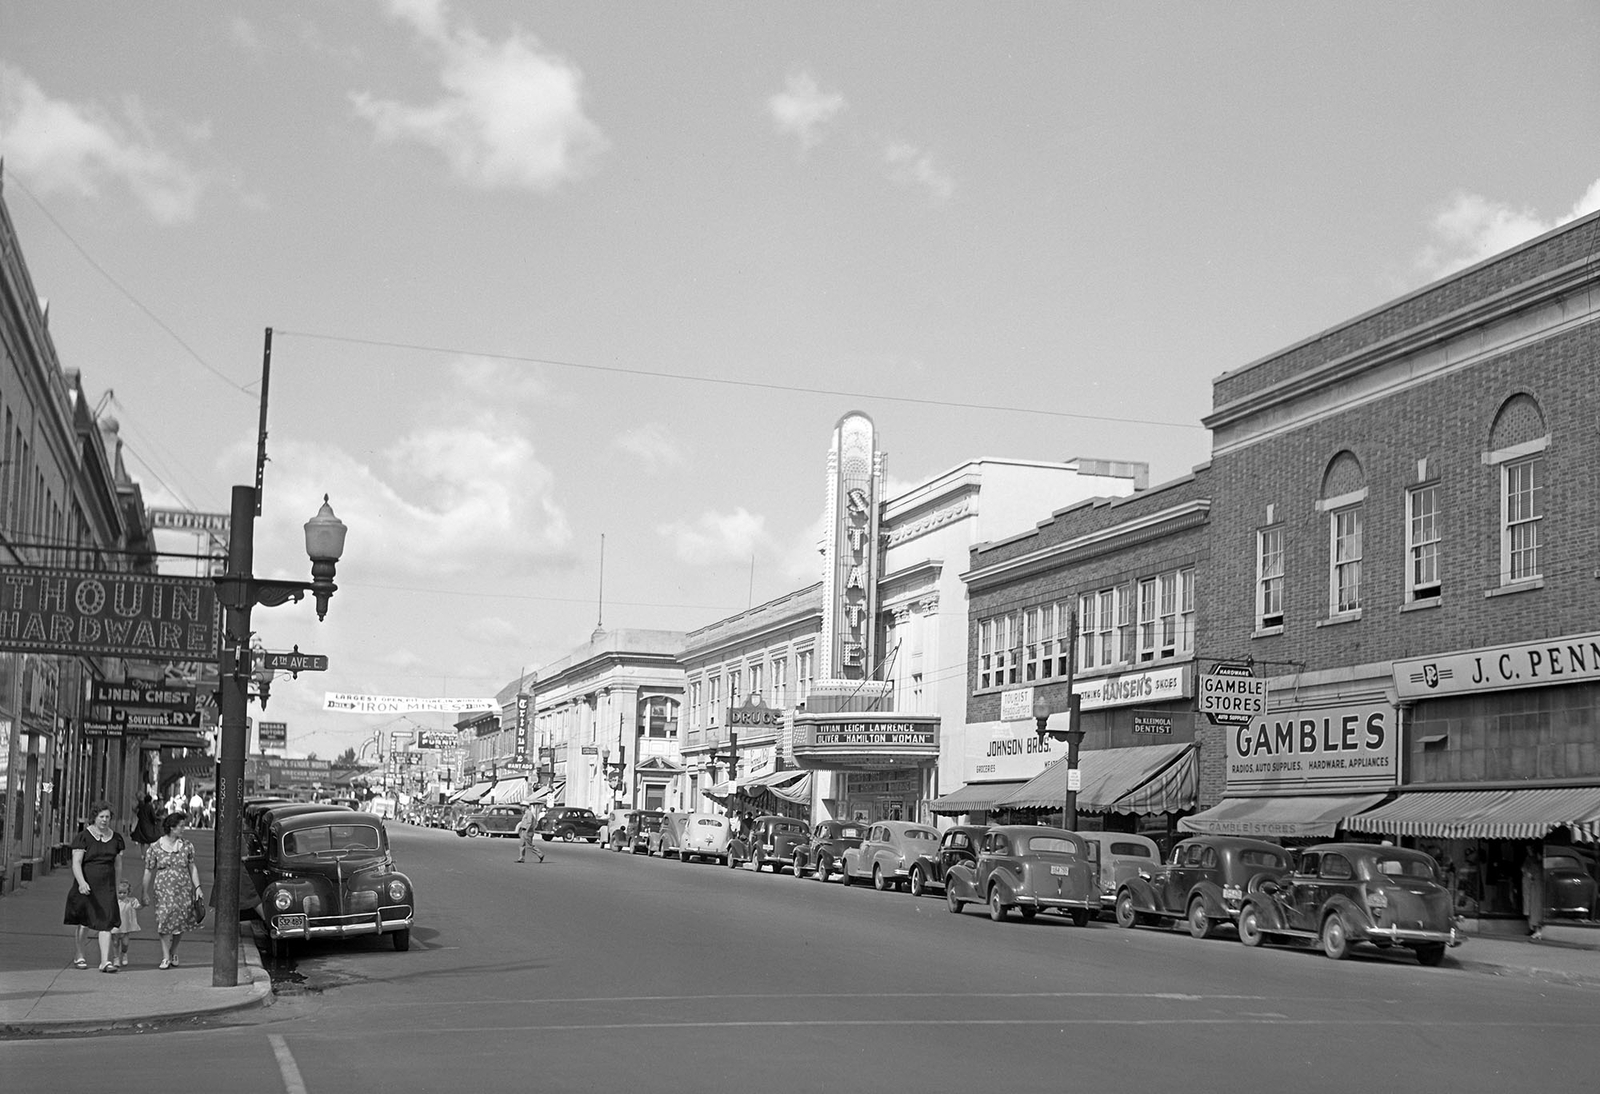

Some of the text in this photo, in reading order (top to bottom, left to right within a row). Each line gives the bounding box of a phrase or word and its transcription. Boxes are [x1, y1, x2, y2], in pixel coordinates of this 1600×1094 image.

[844, 488, 868, 666] STATE
[6, 576, 200, 621] THOUIN
[0, 610, 207, 650] HARDWARE
[271, 655, 323, 669] 4TH AVE. E.
[1472, 658, 1490, 684] J.
[1499, 654, 1520, 680] C.
[1219, 669, 1250, 677] HARDWARE
[1102, 677, 1153, 702] HANSEN'S
[1205, 678, 1263, 695] GAMBLE
[99, 688, 140, 702] LINEN
[145, 691, 191, 704] CHEST
[335, 694, 378, 702] LARGEST
[1205, 695, 1262, 712] STORES
[361, 702, 399, 712] IRON
[407, 703, 461, 711] MINES
[128, 714, 169, 726] SOUVENIRS
[820, 723, 915, 733] VIVIAN LEIGH LAWRENCE
[1134, 725, 1171, 734] DENTIST
[1236, 712, 1385, 757] GAMBLES
[817, 735, 839, 744] OLIVER
[986, 739, 1023, 757] JOHNSON
[976, 764, 996, 773] GROCERIES
[1255, 763, 1271, 773] AUTO
[1348, 757, 1389, 768] APPLIANCES
[1209, 822, 1296, 833] GAMBLE STORES
